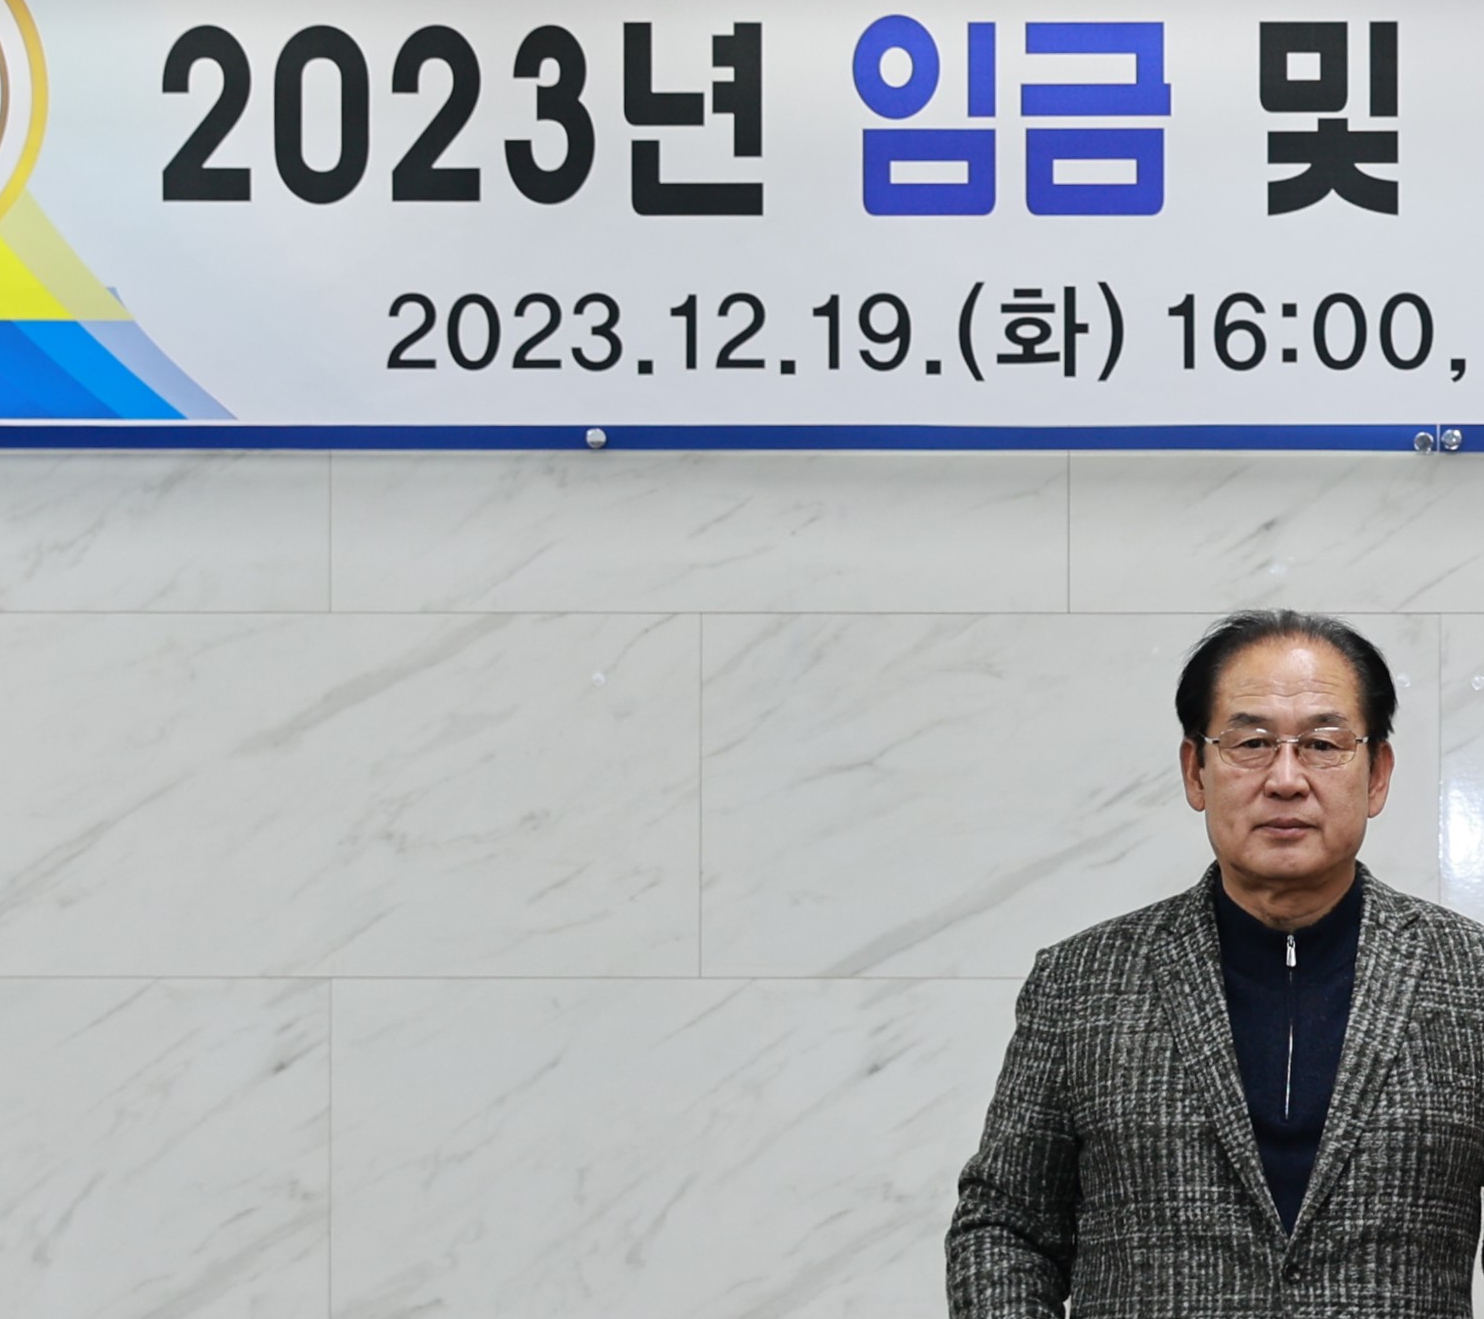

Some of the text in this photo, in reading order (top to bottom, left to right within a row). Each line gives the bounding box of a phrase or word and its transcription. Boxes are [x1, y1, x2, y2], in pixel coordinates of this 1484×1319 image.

[161, 21, 764, 217] 2023년
[851, 14, 1172, 217] 임금
[1258, 21, 1399, 217] 및
[386, 281, 1125, 382] 2023.12.19.(화)
[1167, 291, 1467, 383] 16:00,
